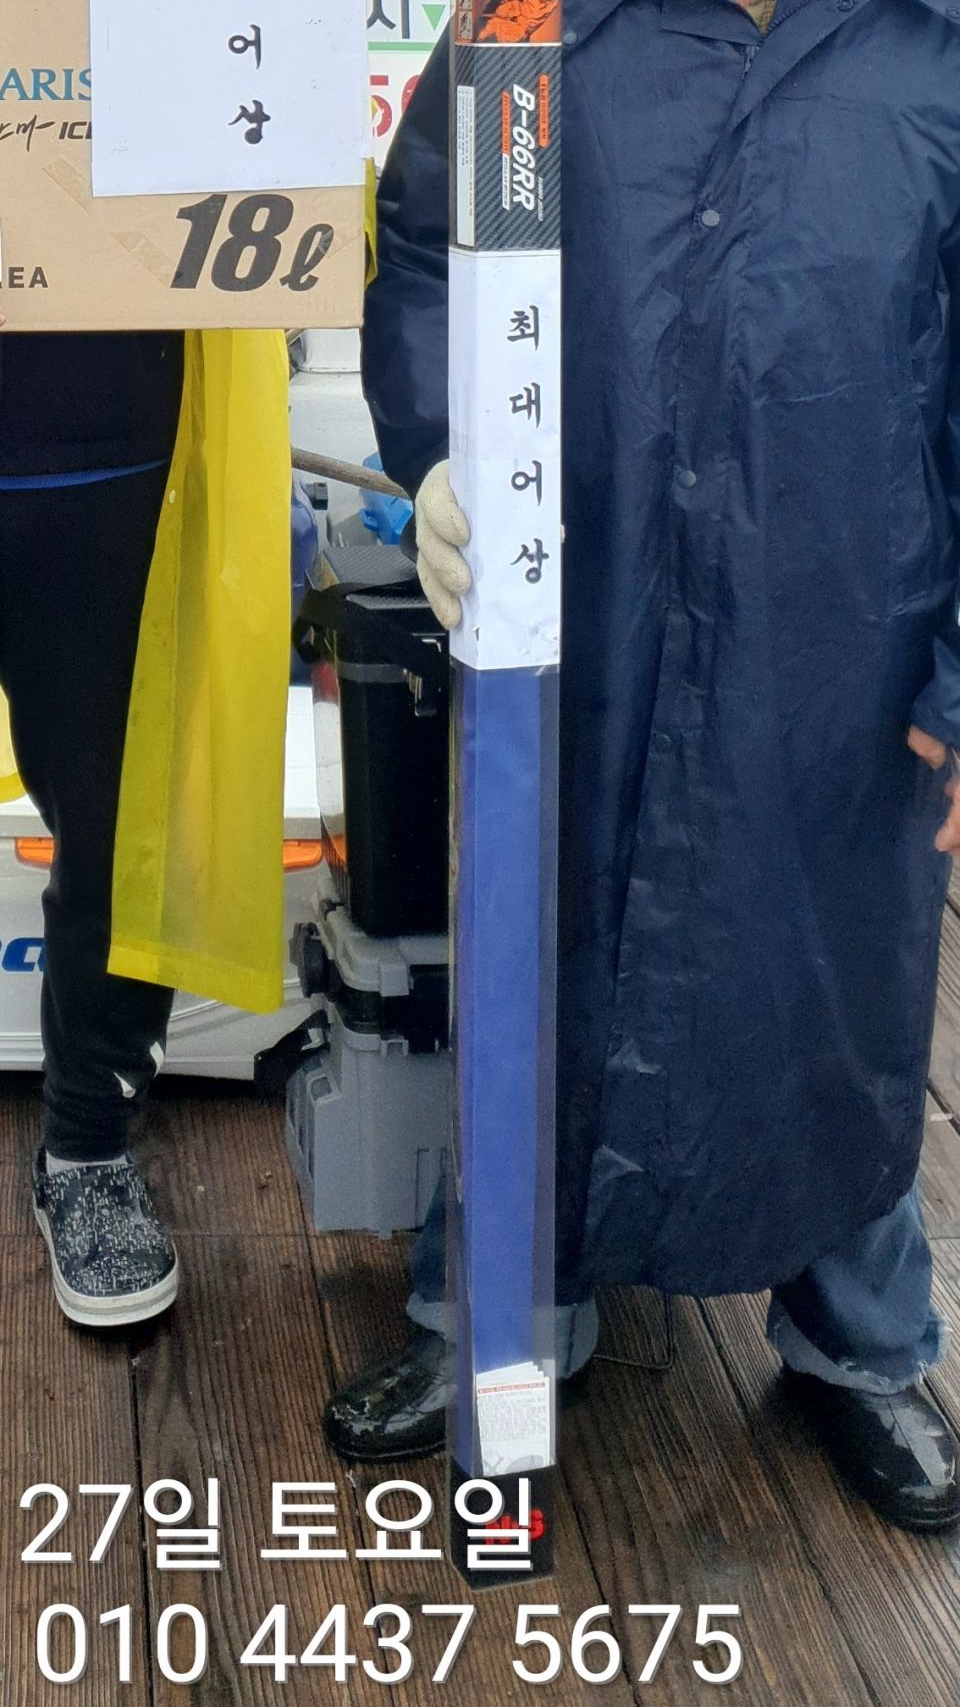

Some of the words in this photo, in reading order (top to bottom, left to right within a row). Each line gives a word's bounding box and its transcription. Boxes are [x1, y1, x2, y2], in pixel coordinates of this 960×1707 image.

[58, 121, 92, 140] IC
[512, 83, 536, 212] B-66RR
[506, 305, 550, 584] 최대어상
